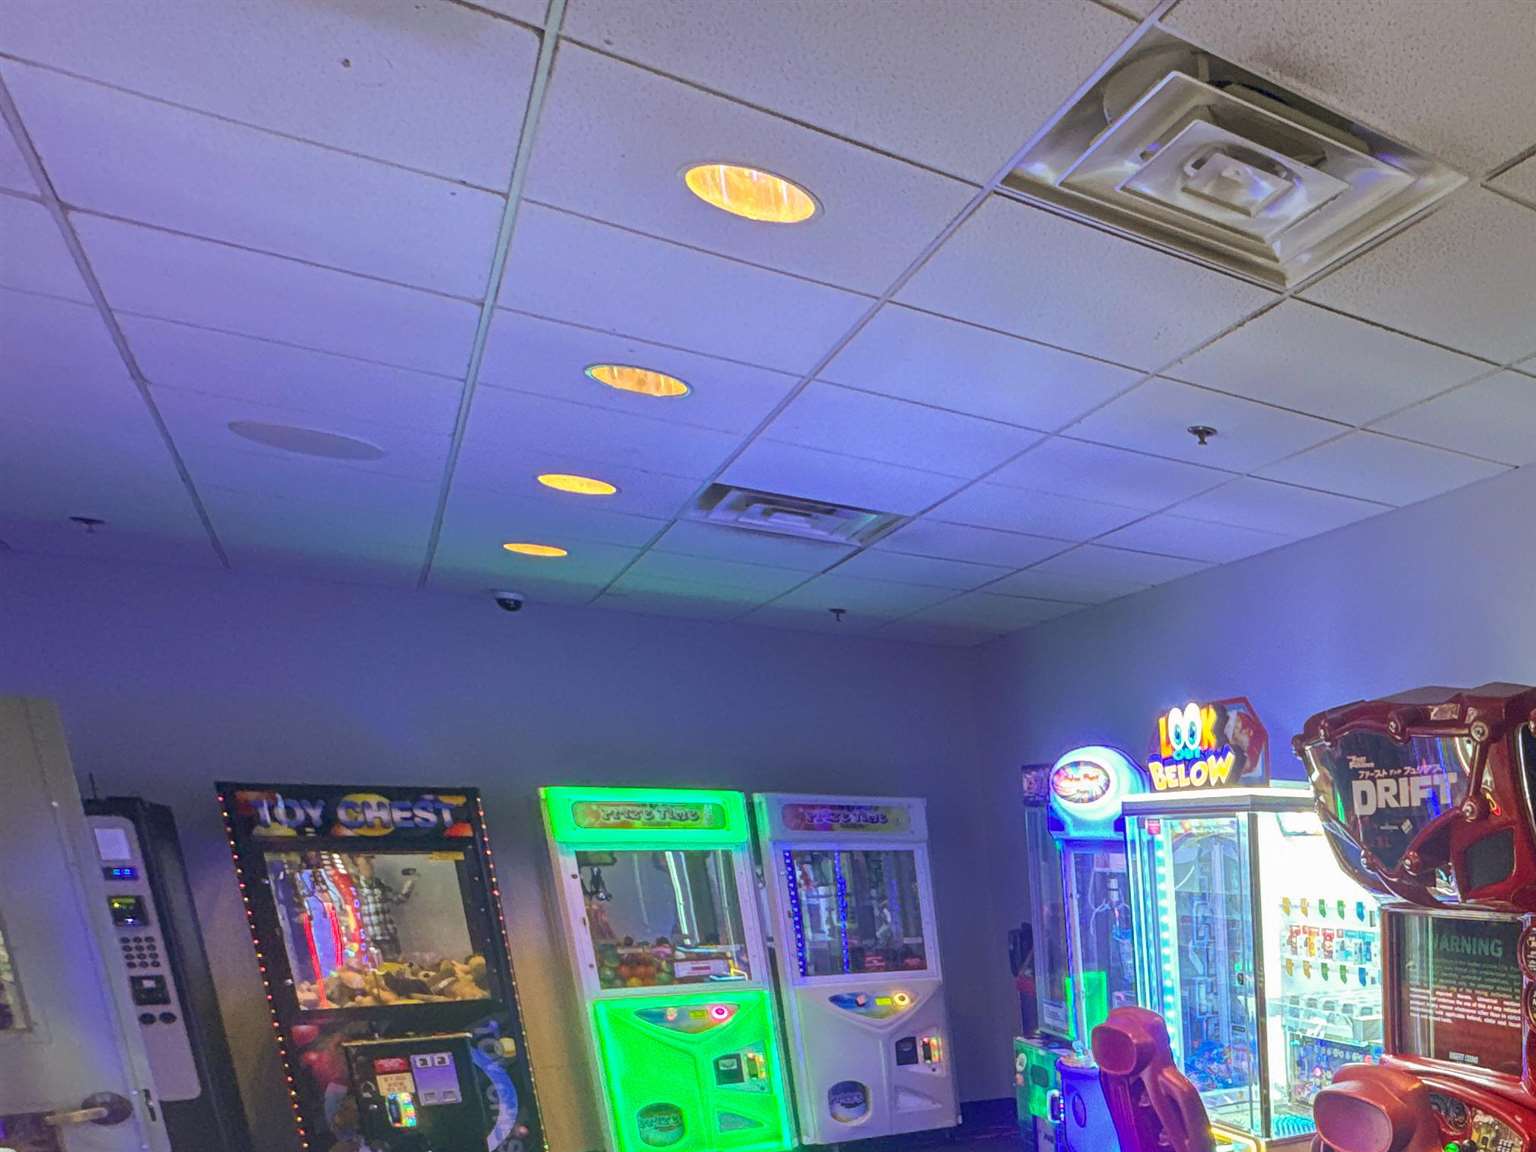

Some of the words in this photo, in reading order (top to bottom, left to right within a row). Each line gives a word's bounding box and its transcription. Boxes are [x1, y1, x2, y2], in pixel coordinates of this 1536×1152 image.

[1159, 703, 1217, 759] LOOK
[1149, 751, 1235, 791] BELOW
[252, 795, 326, 828] TOY
[336, 799, 458, 830] CHEST
[1352, 772, 1458, 816] DRIFT
